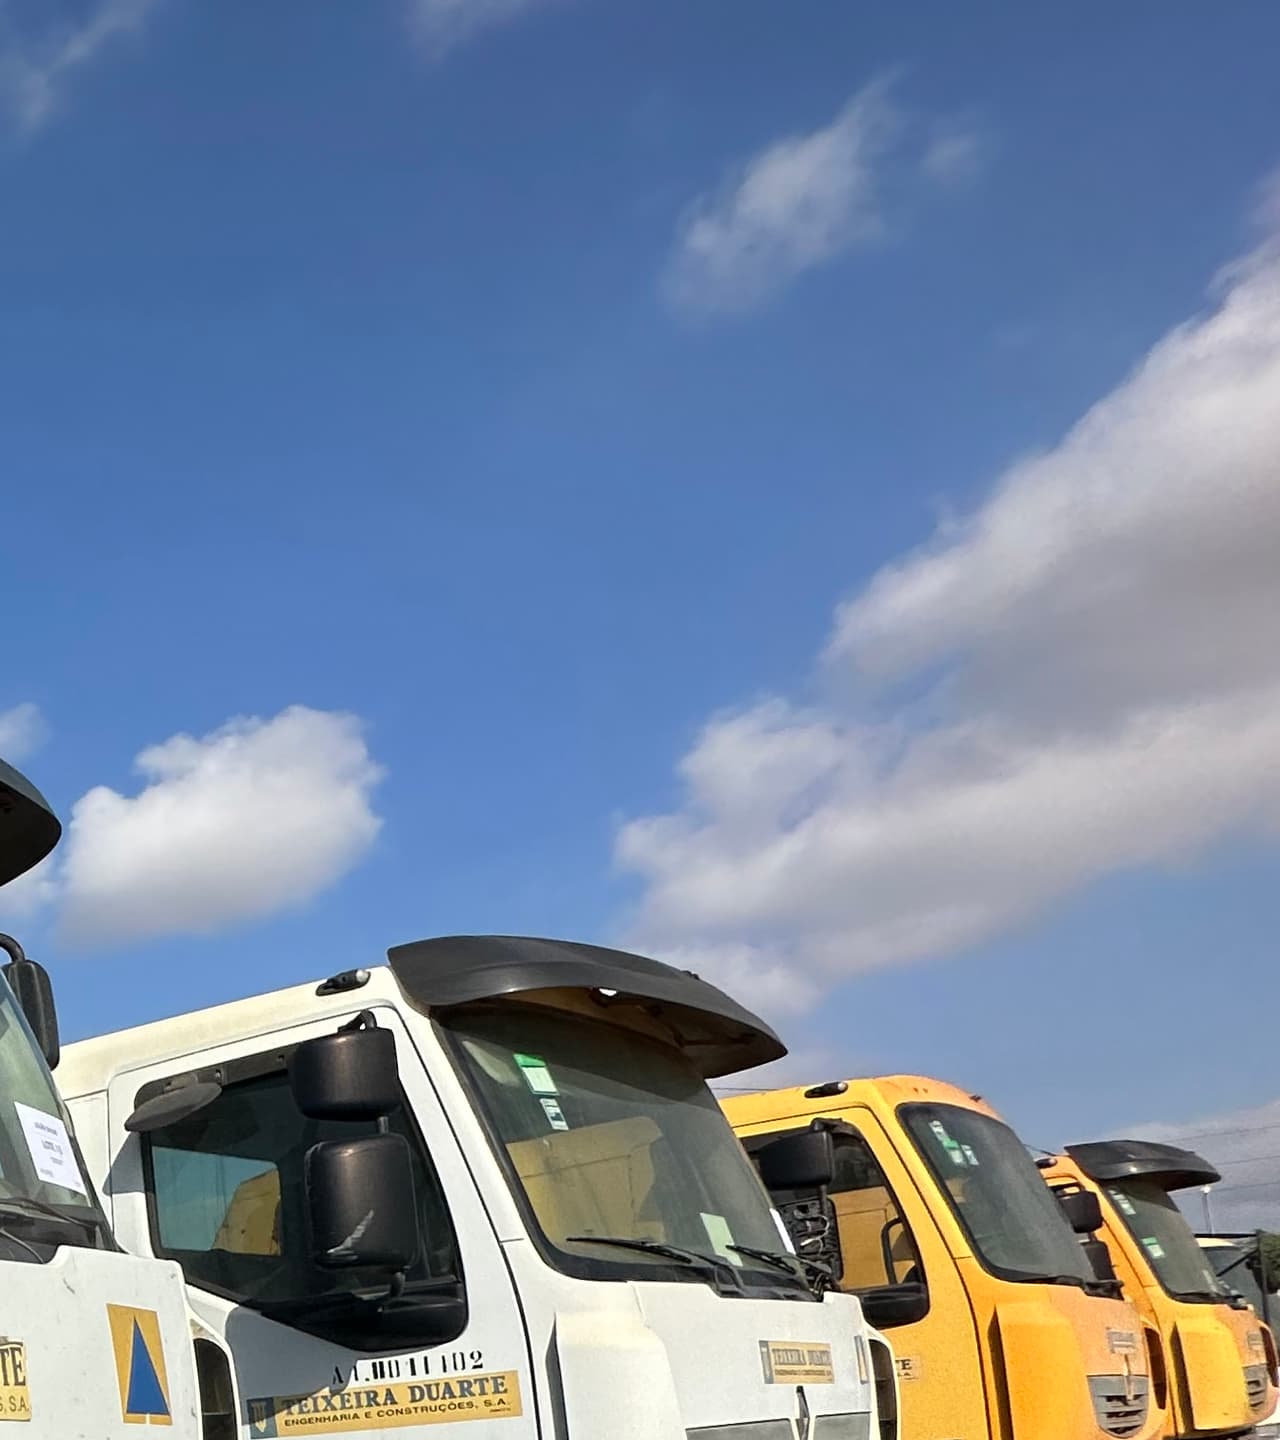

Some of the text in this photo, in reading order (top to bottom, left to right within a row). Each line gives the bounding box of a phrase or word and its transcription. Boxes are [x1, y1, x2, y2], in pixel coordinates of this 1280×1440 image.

[282, 1375, 509, 1416] TEIXEIRA DUARTE
[284, 1411, 360, 1427] ENGENHARIA
[364, 1410, 373, 1420] E
